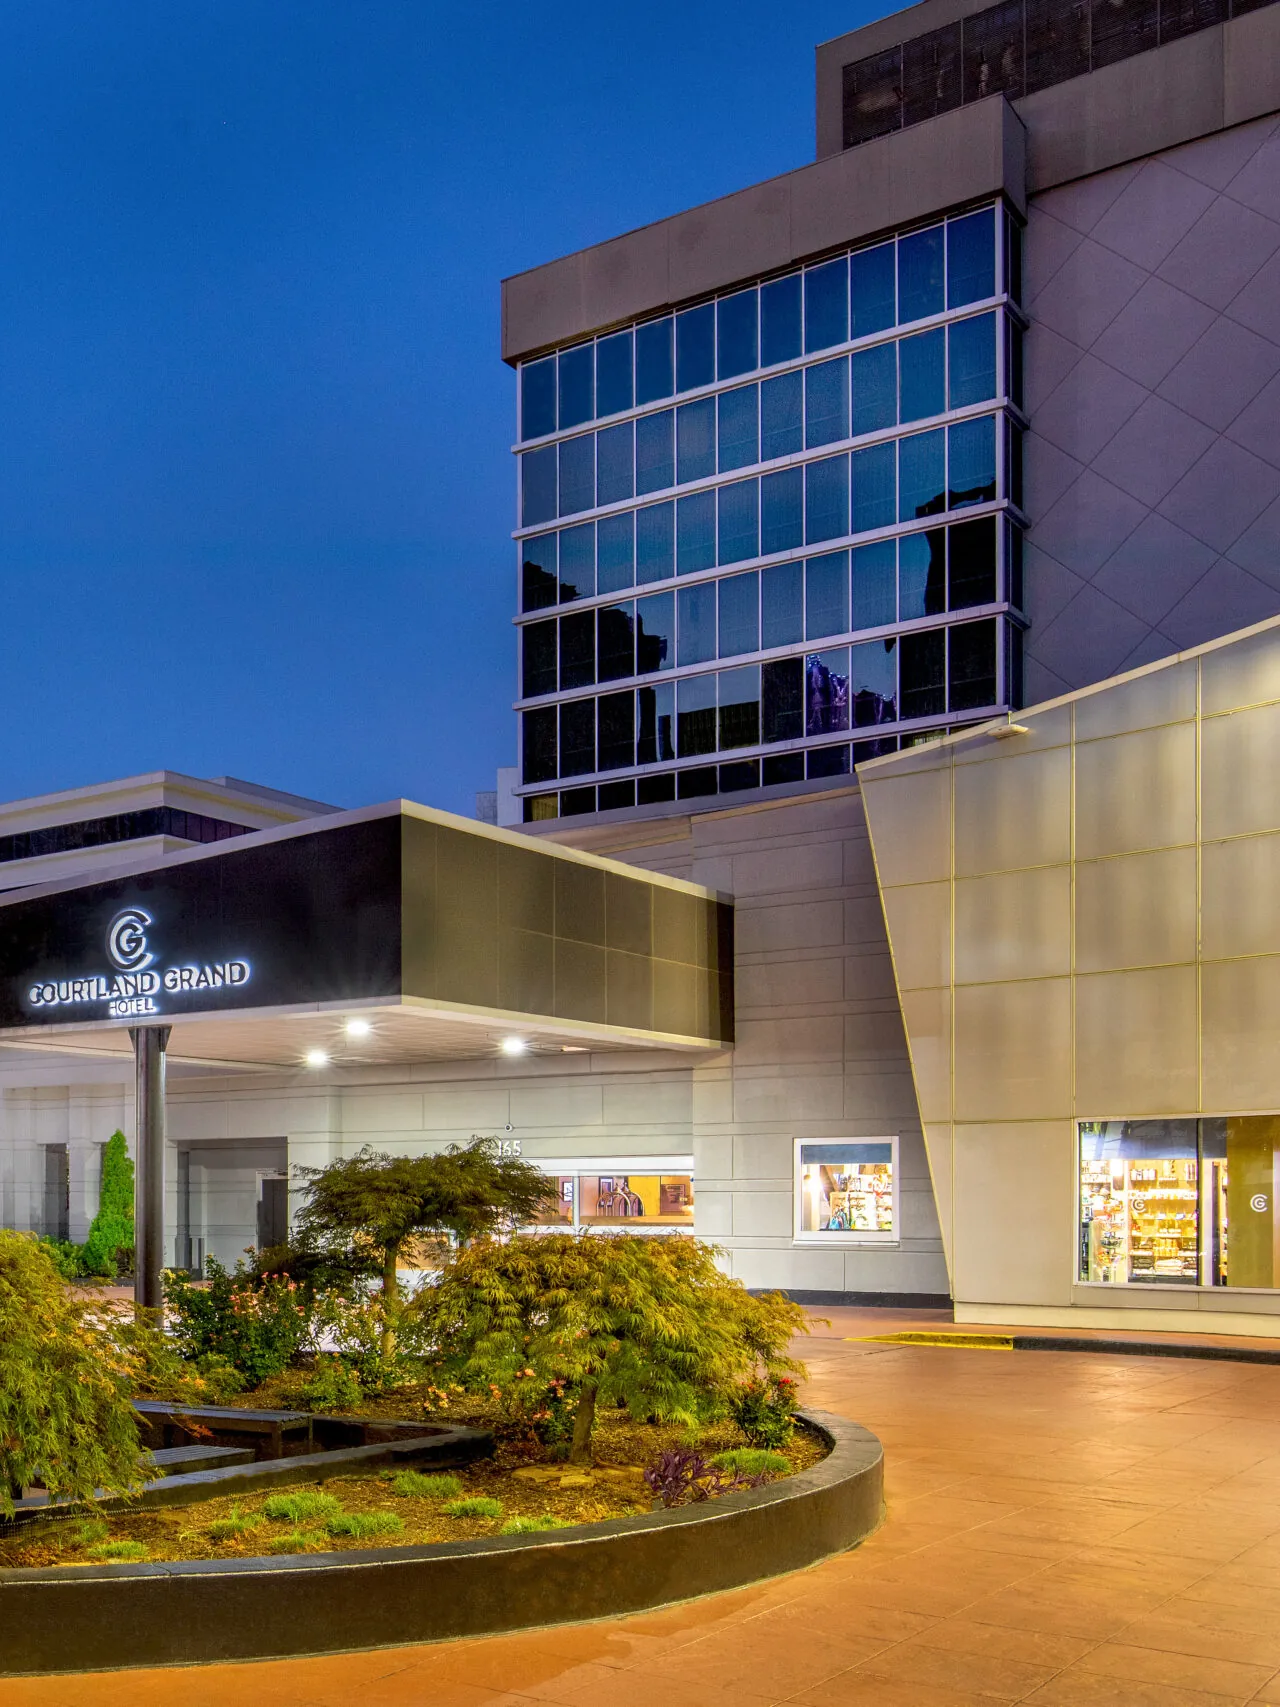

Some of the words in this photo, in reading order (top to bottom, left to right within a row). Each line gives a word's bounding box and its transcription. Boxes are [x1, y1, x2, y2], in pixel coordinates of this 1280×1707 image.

[29, 971, 160, 1006] COURTLAND
[164, 961, 250, 993] GRAND
[108, 997, 157, 1016] HOTEL
[499, 1140, 521, 1156] 165
